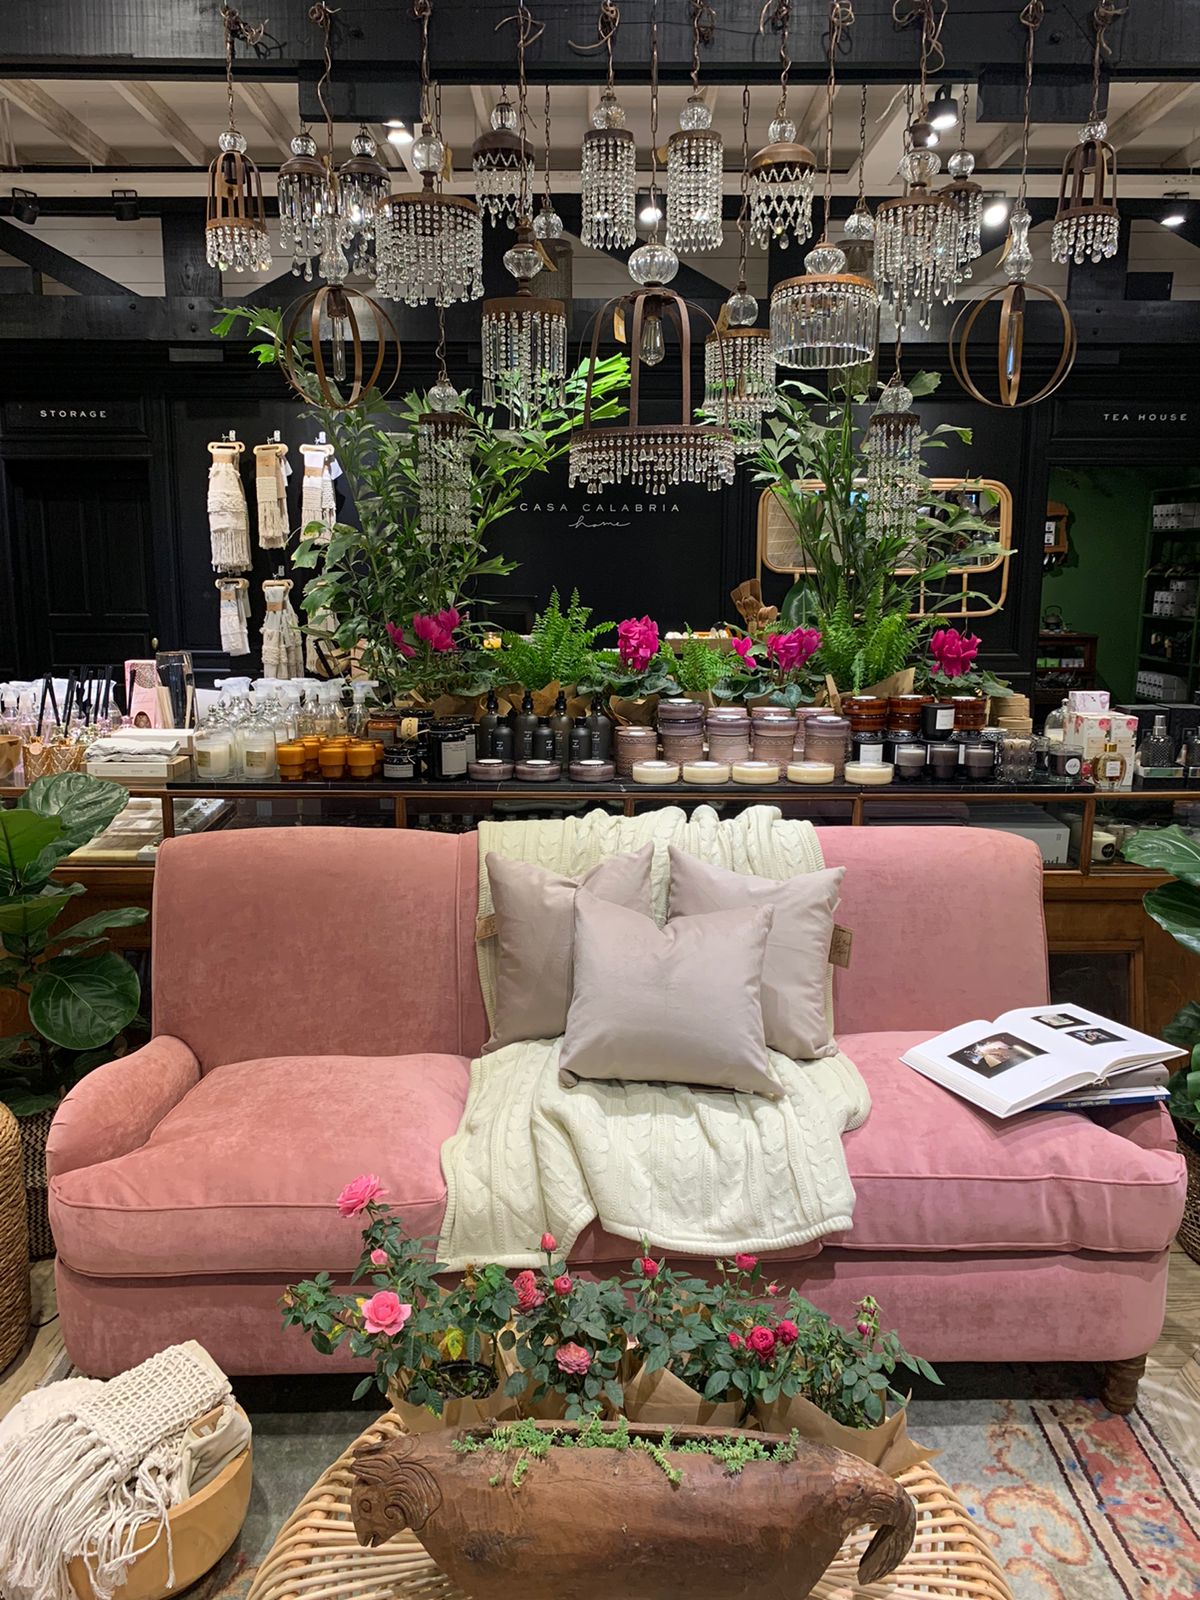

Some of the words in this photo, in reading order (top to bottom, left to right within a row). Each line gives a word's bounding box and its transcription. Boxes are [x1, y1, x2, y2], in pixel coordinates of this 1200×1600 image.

[40, 409, 107, 418] STORAGE
[1103, 413, 1129, 421] TEA
[1138, 413, 1187, 421] HOUSE
[519, 502, 568, 512] CASA
[582, 503, 680, 512] CALABRIA
[568, 514, 631, 529] home
